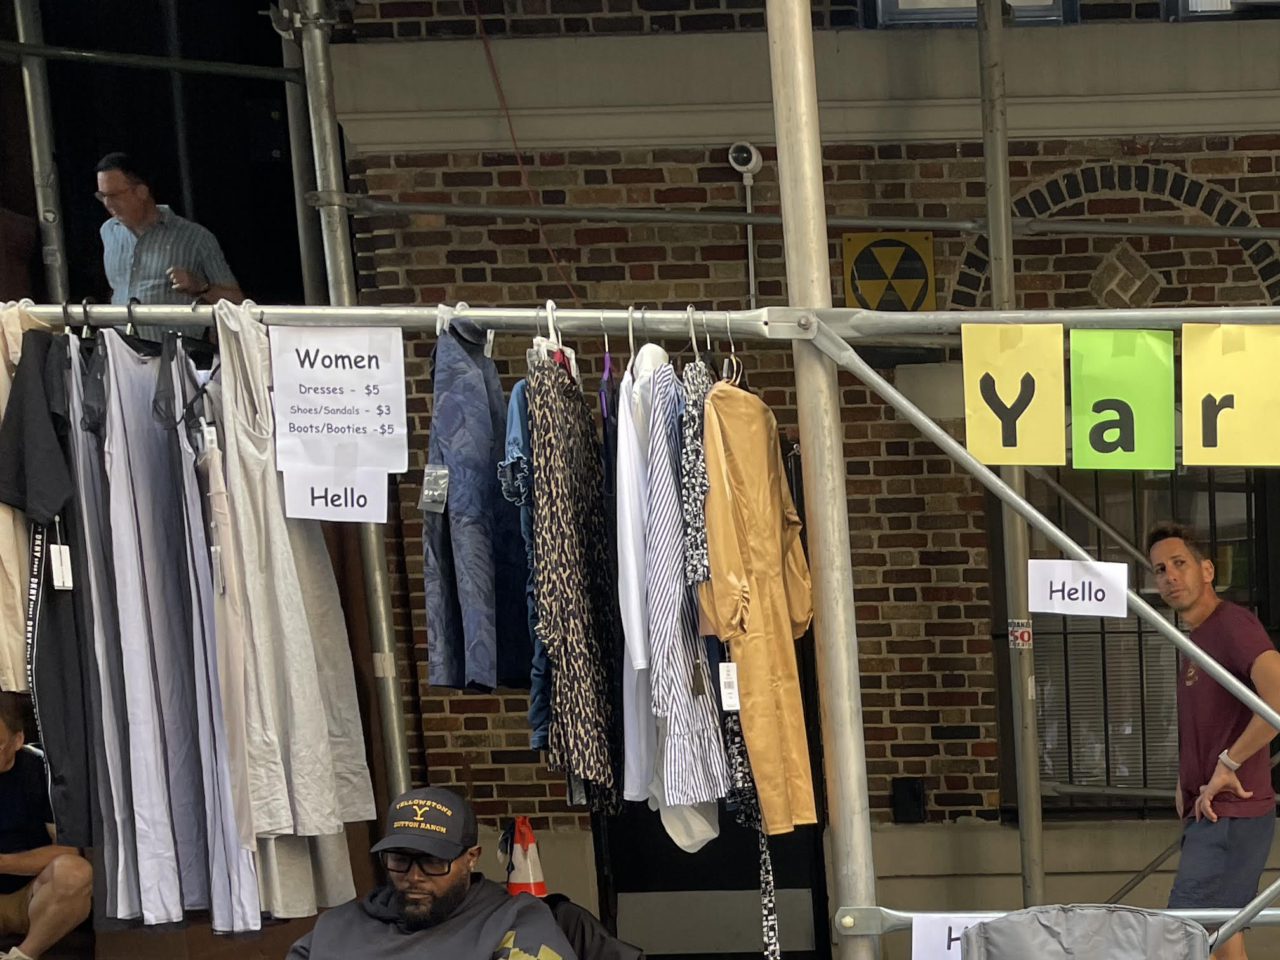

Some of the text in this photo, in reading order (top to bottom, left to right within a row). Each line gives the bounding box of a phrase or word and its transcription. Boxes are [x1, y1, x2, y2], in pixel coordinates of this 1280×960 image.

[295, 347, 380, 370] Women
[299, 383, 345, 395] Dresses
[364, 384, 380, 397] $5
[290, 405, 360, 416] Shoes/Sandals
[376, 404, 391, 417] $3
[288, 422, 368, 435] Boots/Booties
[310, 486, 368, 508] Hello
[34, 534, 43, 558] DKNY
[29, 577, 39, 601] DKNY
[1049, 580, 1106, 602] Hello
[26, 620, 34, 645] DKNY
[420, 822, 447, 834] RANCH
